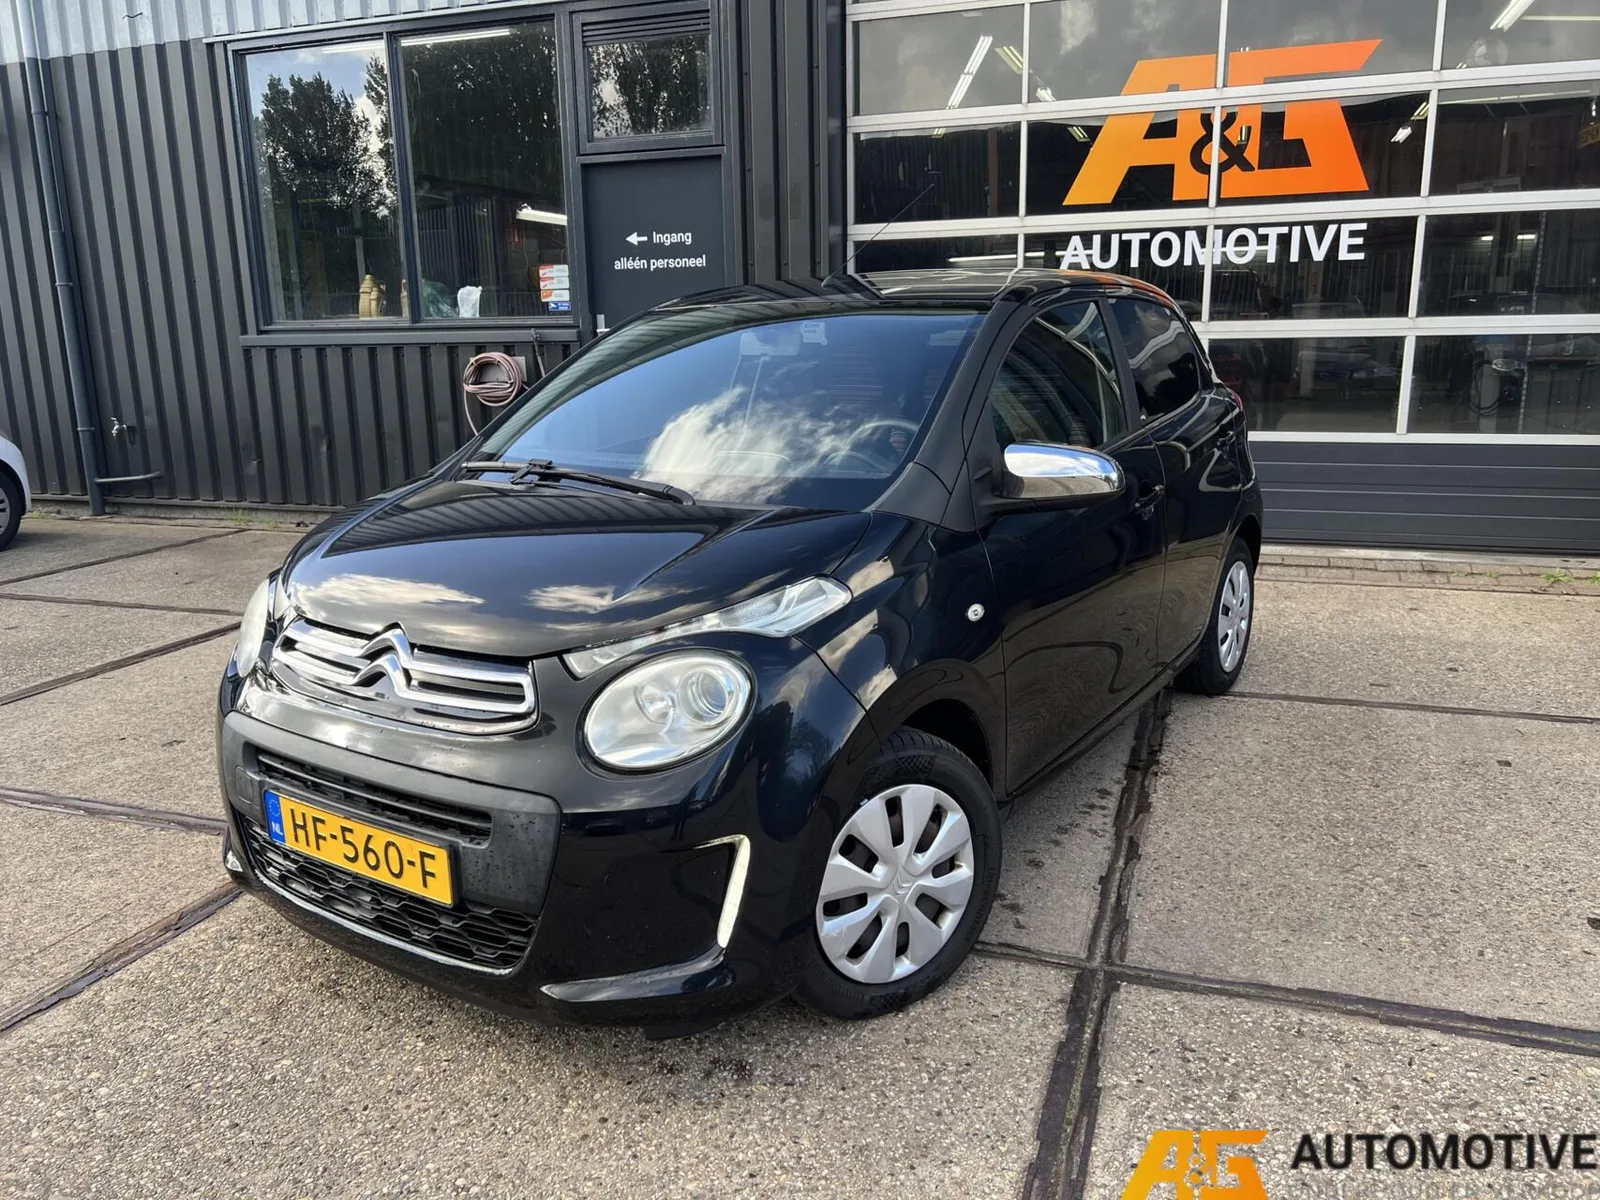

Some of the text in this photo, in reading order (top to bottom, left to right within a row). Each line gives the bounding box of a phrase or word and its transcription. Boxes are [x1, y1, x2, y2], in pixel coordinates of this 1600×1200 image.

[652, 231, 692, 245] Ingang
[1060, 222, 1368, 270] AUTOMOTIVE
[614, 254, 706, 271] alléén personeel
[271, 822, 284, 835] NL
[290, 808, 436, 889] HF-560-F
